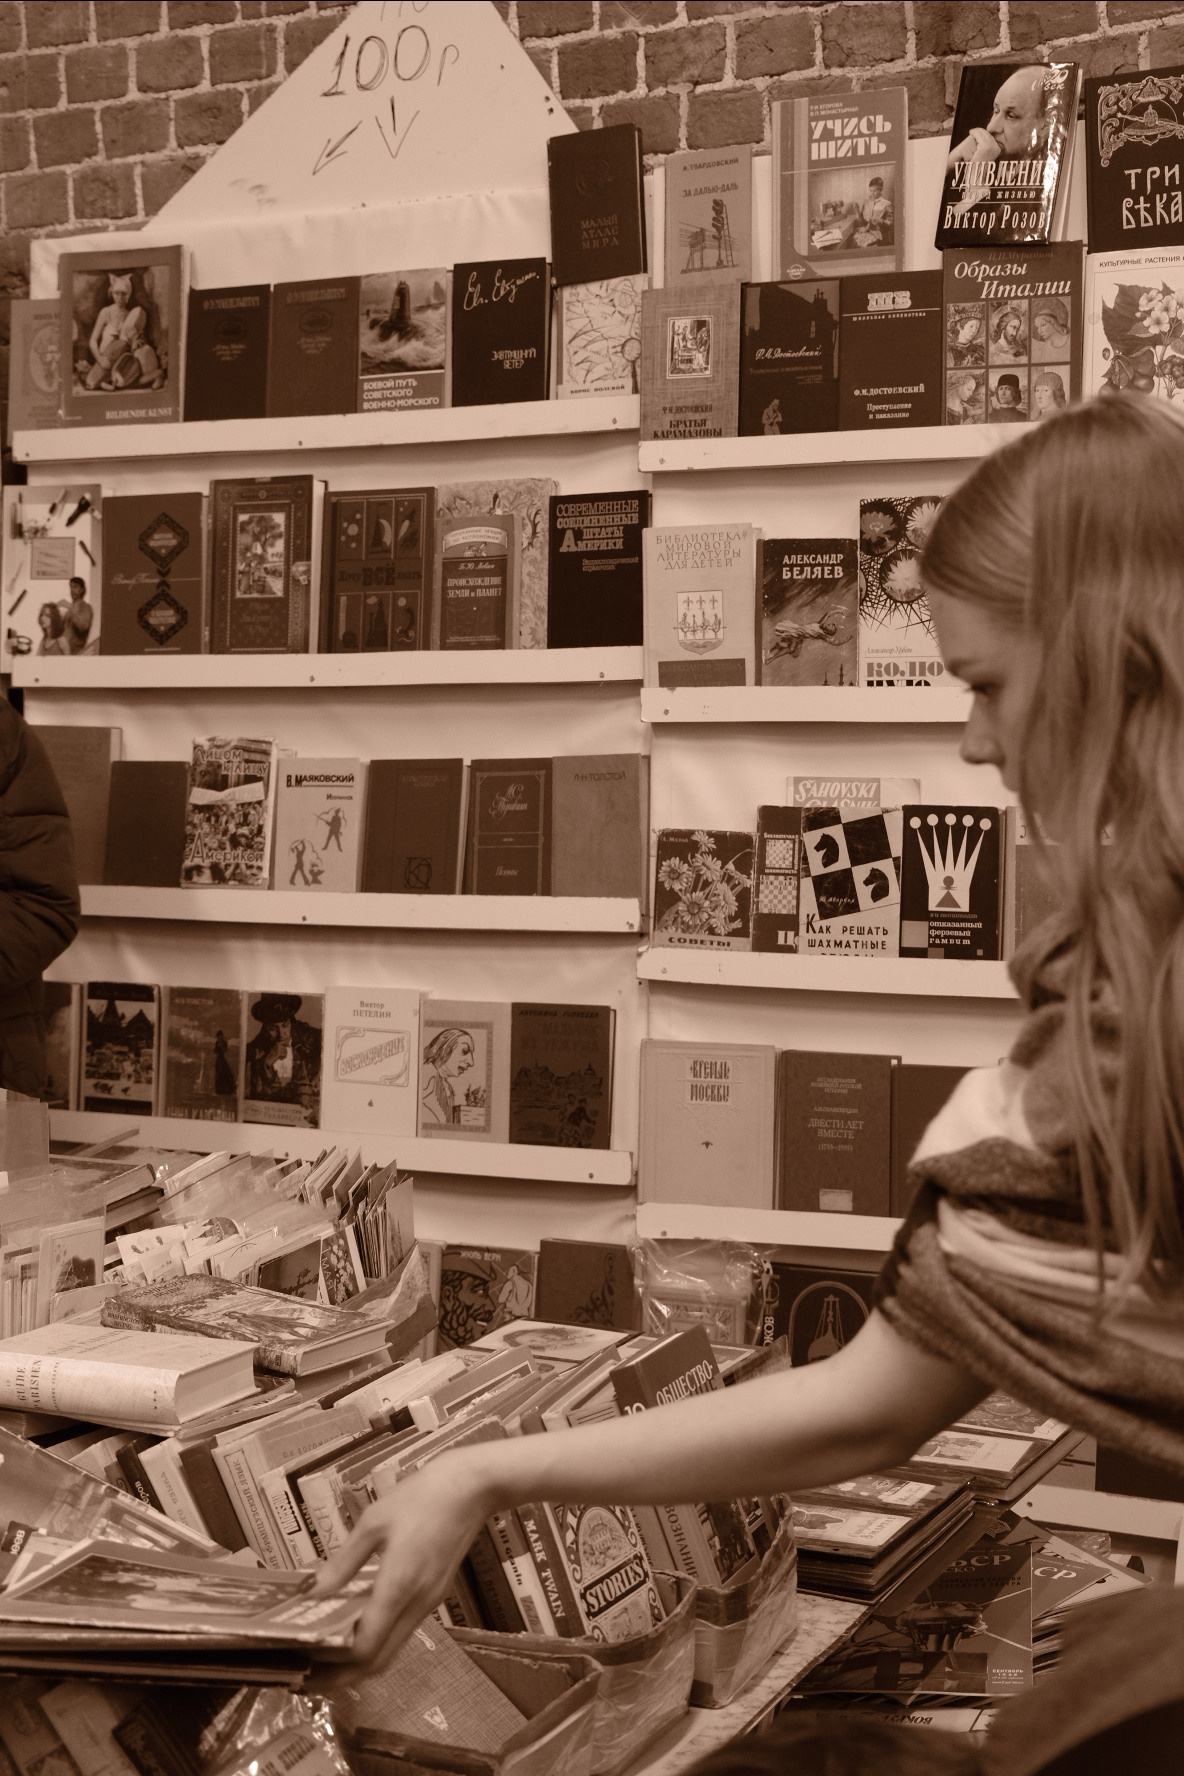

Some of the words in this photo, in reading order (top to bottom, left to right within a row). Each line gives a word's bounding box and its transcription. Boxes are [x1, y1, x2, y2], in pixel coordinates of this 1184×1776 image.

[811, 115, 892, 140] УЧИСЬ
[811, 136, 887, 160] ШИТЬ
[952, 160, 1046, 192] УДИВЛЕНИ
[1124, 164, 1180, 195] ТРИ
[682, 189, 692, 198] ЗА
[581, 214, 618, 230] МАЛЫЙ
[943, 205, 996, 235] Виктор
[1000, 204, 1046, 229] Розов
[582, 226, 619, 240] АТЛАС
[582, 236, 619, 250] МИРА
[1099, 258, 1143, 268] КУЛЬТУРНЫЕ
[1144, 255, 1180, 265] РАСТЕНИЯ
[954, 260, 1028, 283] Образы
[980, 278, 1071, 299] Италии
[363, 380, 395, 391] БОЕВОЙ
[395, 378, 418, 389] ПУТЬ
[363, 388, 414, 400] СОВЕТСКОГО
[363, 396, 440, 411] ВОЕННО-МОРСКОГО
[867, 403, 912, 412] Преступление
[670, 418, 707, 429] БРАТЬЯ
[653, 428, 723, 440] КАРАМАЗОВЫ
[557, 500, 639, 517] СОВРЕМЕННЫЕ
[557, 513, 639, 530] СОЕДИНЕННЫЕ
[582, 526, 624, 540] ШТАТЫ
[656, 531, 741, 545] БИБЛИОТЕКА
[666, 540, 731, 553] МИРОВОЙ
[656, 549, 741, 562] ЛИТЕРАТУРЫ
[782, 553, 844, 565] АЛЕКСАНДР
[664, 559, 688, 571] ДЛЯ
[691, 557, 733, 569] ДЕТЕЙ
[782, 566, 844, 580] БЕЛЯЕВ
[447, 576, 503, 587] ПРОИСХОЖДЕНИЕ
[447, 589, 470, 599] ЗЕМЛИ
[476, 587, 503, 597] ПЛАНЕТ
[796, 780, 878, 802] ŠAHOVSKI
[842, 925, 888, 936] РЕШАТЬ
[929, 921, 983, 929] отказанный
[929, 929, 971, 938] ферзевый
[668, 937, 731, 947] СОВЕТЫ
[807, 938, 887, 950] ШАХМАТНЫЕ
[360, 1000, 386, 1010] Виктор
[352, 1009, 392, 1018] ПЕТЕЛИН
[808, 1118, 845, 1129] ДВЕСТИ
[846, 1120, 865, 1130] ЛЕТ
[817, 1129, 855, 1139] ВМЕСТЕ
[484, 1252, 502, 1262] ВЕРН
[16, 1367, 27, 1401] GUIDE
[233, 1459, 249, 1487] ЯЗЫК
[243, 1487, 273, 1554] ФРАНЦУЗСКИЙ
[665, 1505, 698, 1578] ВОЗНАНИЕ
[523, 1519, 547, 1562] MARK
[541, 1568, 566, 1617] TWAIN
[586, 1559, 645, 1613] STORIES
